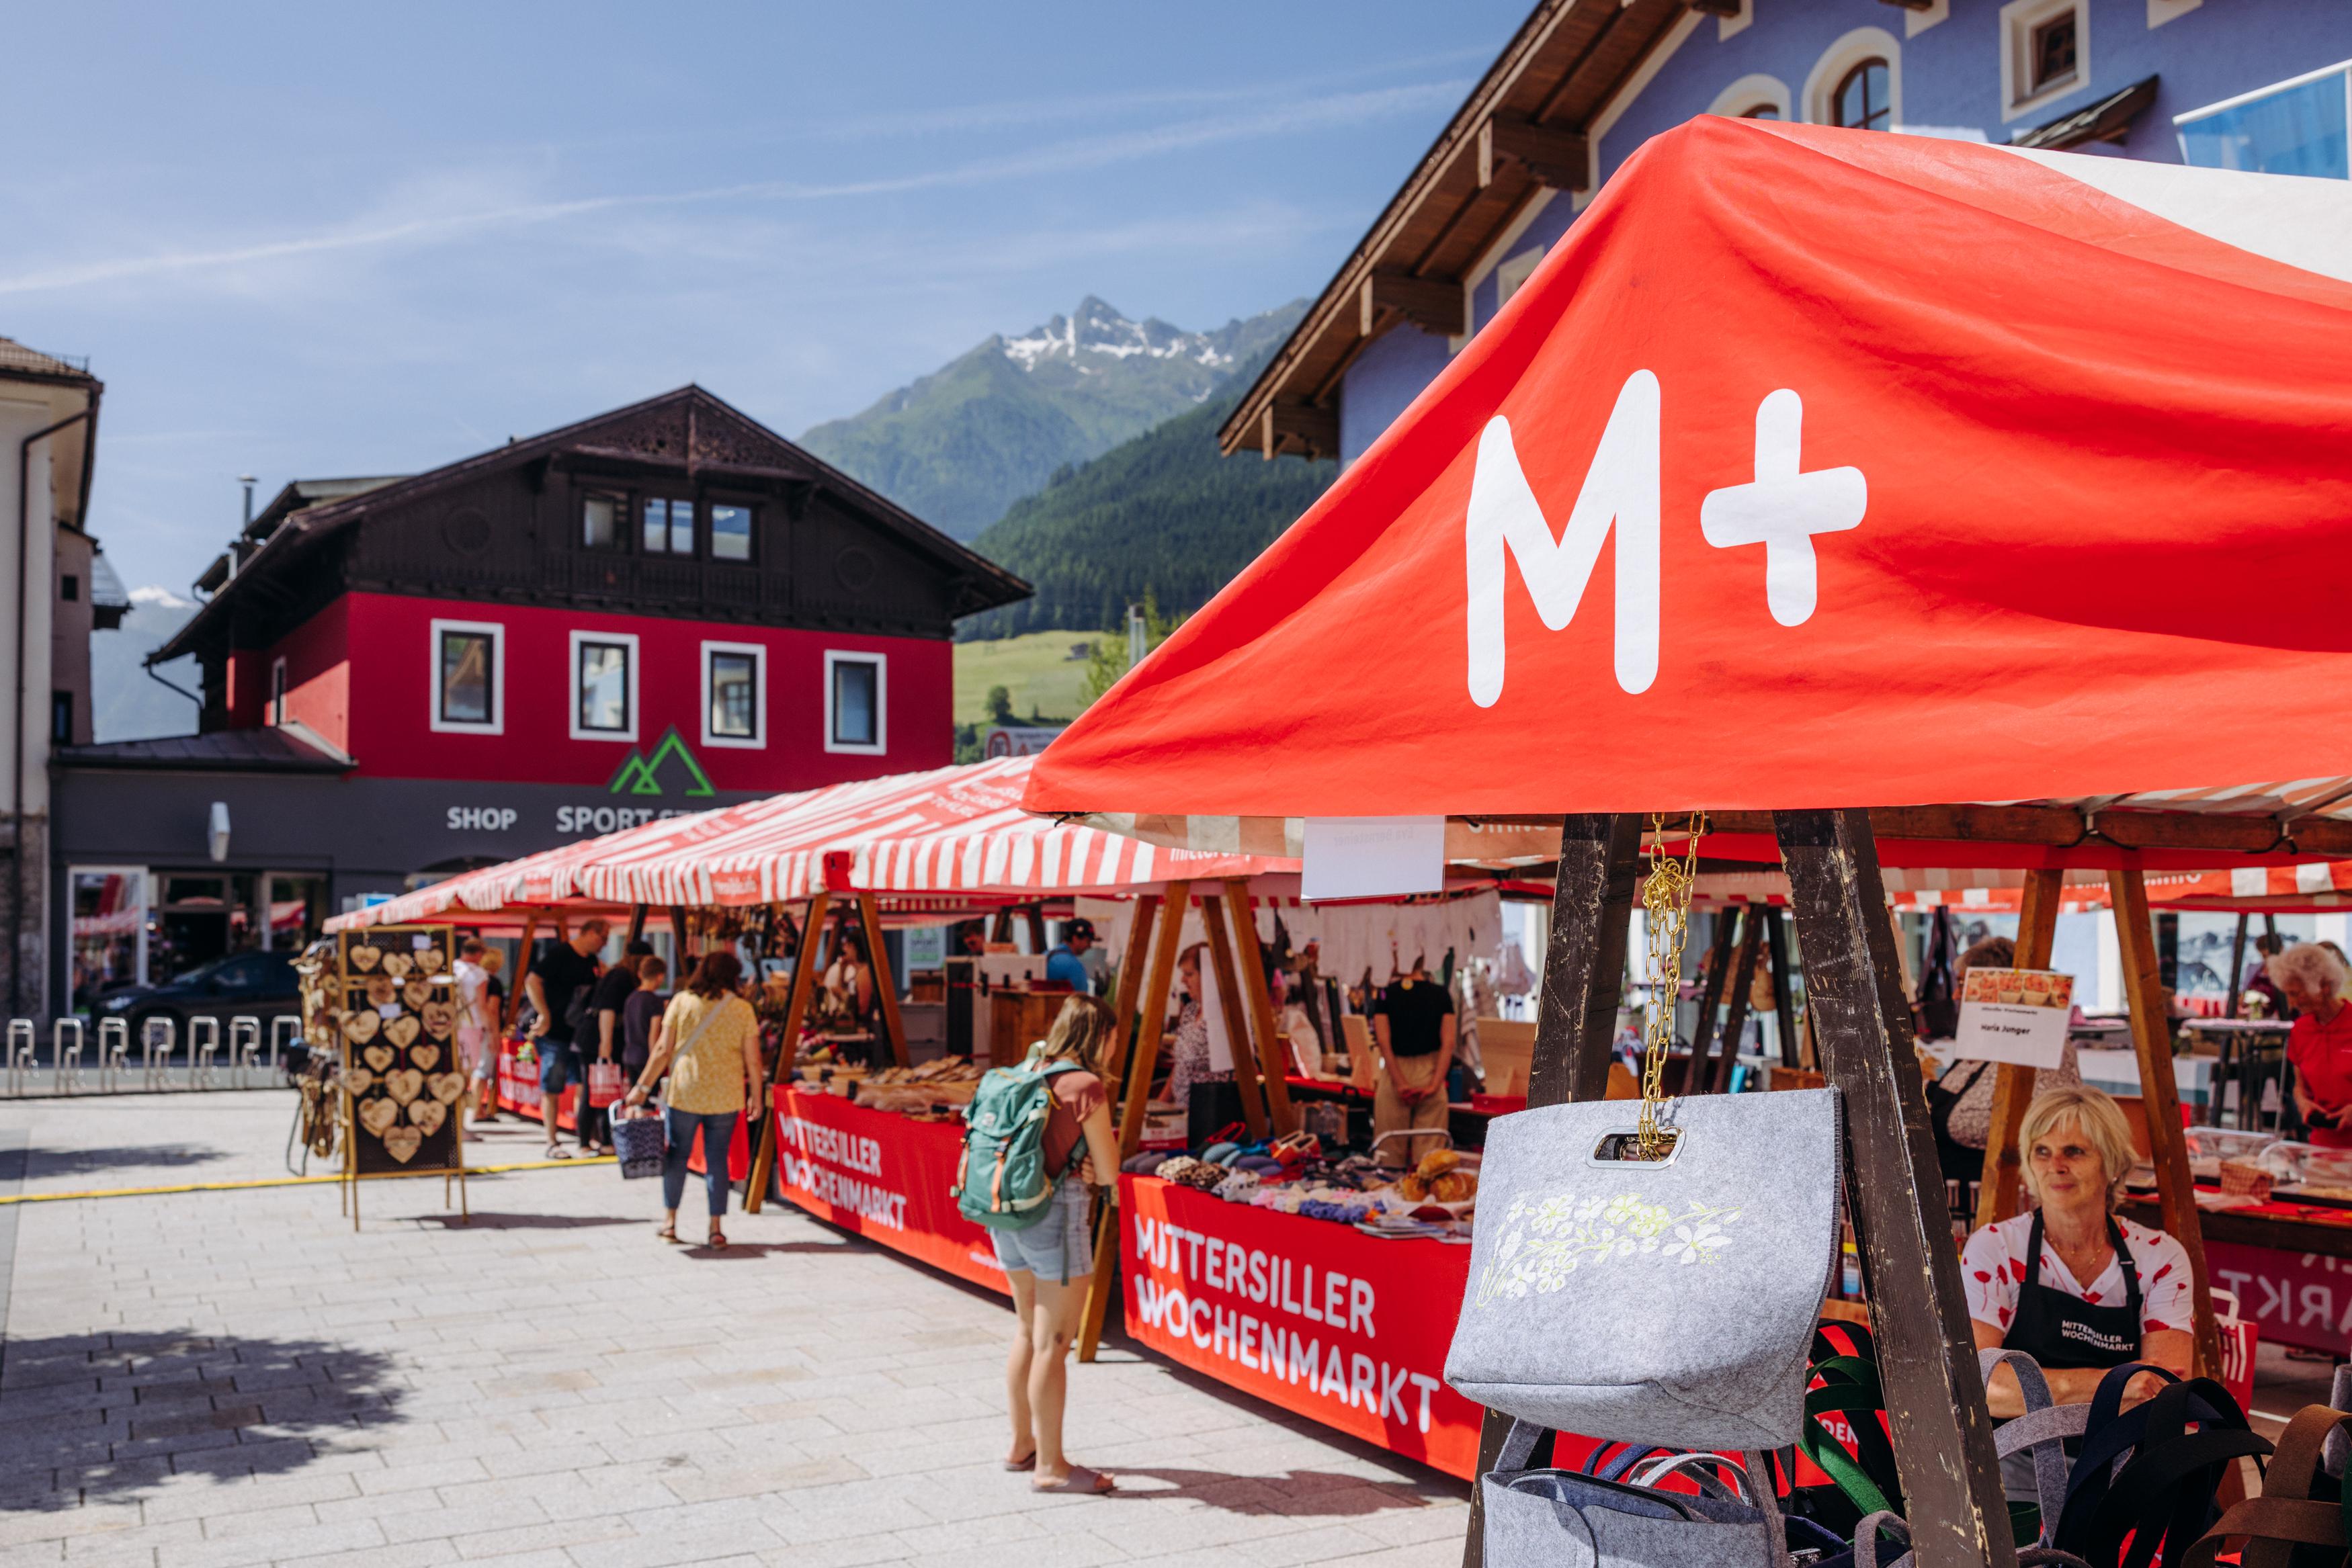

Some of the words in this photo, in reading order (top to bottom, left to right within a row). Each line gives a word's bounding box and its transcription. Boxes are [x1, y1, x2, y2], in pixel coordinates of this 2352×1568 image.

[447, 806, 517, 830] SHOP
[556, 806, 653, 833] SPORT
[1134, 1213, 1376, 1339] MITTERSILLER
[2061, 1319, 2122, 1343] MITTERSILLER
[2061, 1328, 2135, 1352] WOCHENMARKT
[1134, 1273, 1440, 1434] WOCHENMARKT
